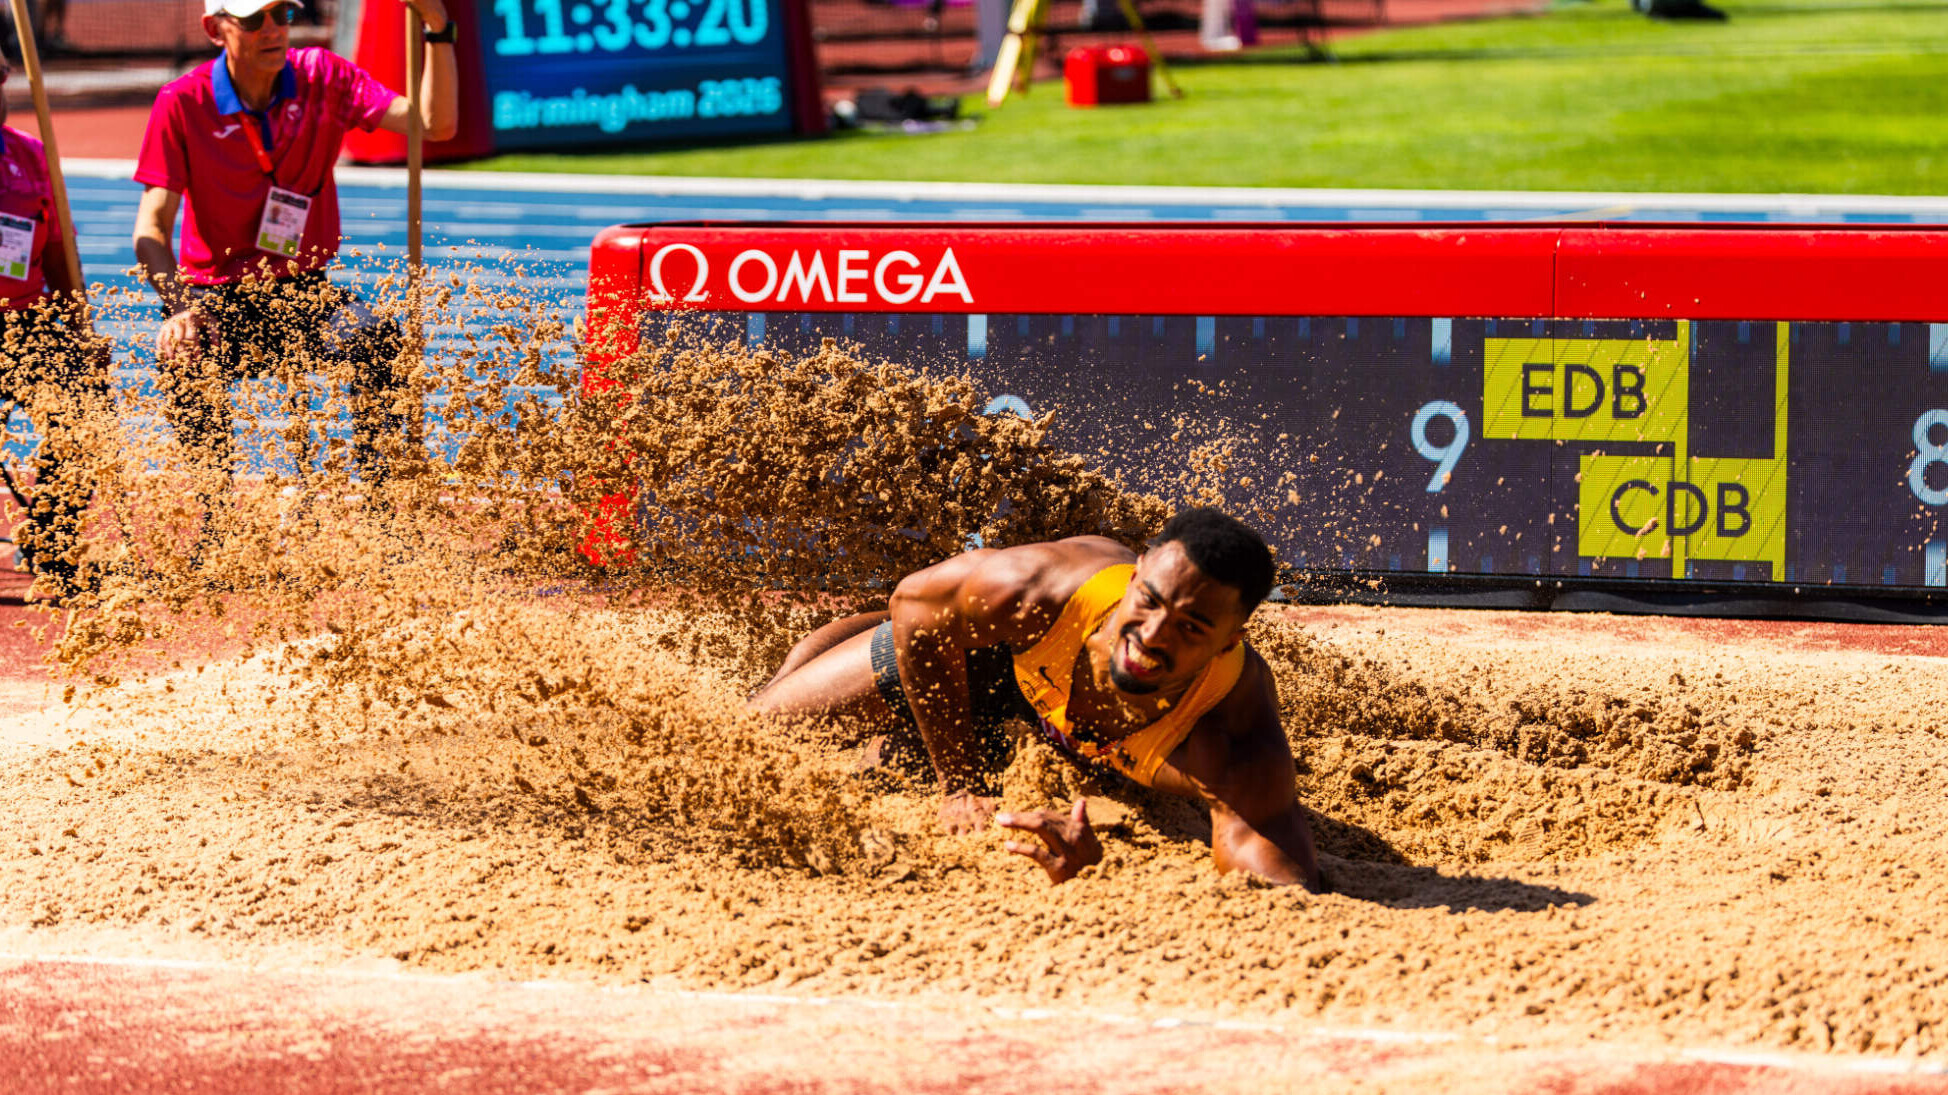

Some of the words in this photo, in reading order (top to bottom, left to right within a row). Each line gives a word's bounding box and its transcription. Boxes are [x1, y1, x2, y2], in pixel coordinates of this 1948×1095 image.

[494, 0, 768, 54] 11:33:20
[493, 85, 695, 132] Birmingham
[697, 77, 782, 117] 2026
[727, 247, 975, 304] OMEGA
[1521, 363, 1648, 419] EDB
[1411, 400, 1470, 492] 9
[1909, 408, 1948, 505] 8
[1610, 479, 1752, 538] CDB
